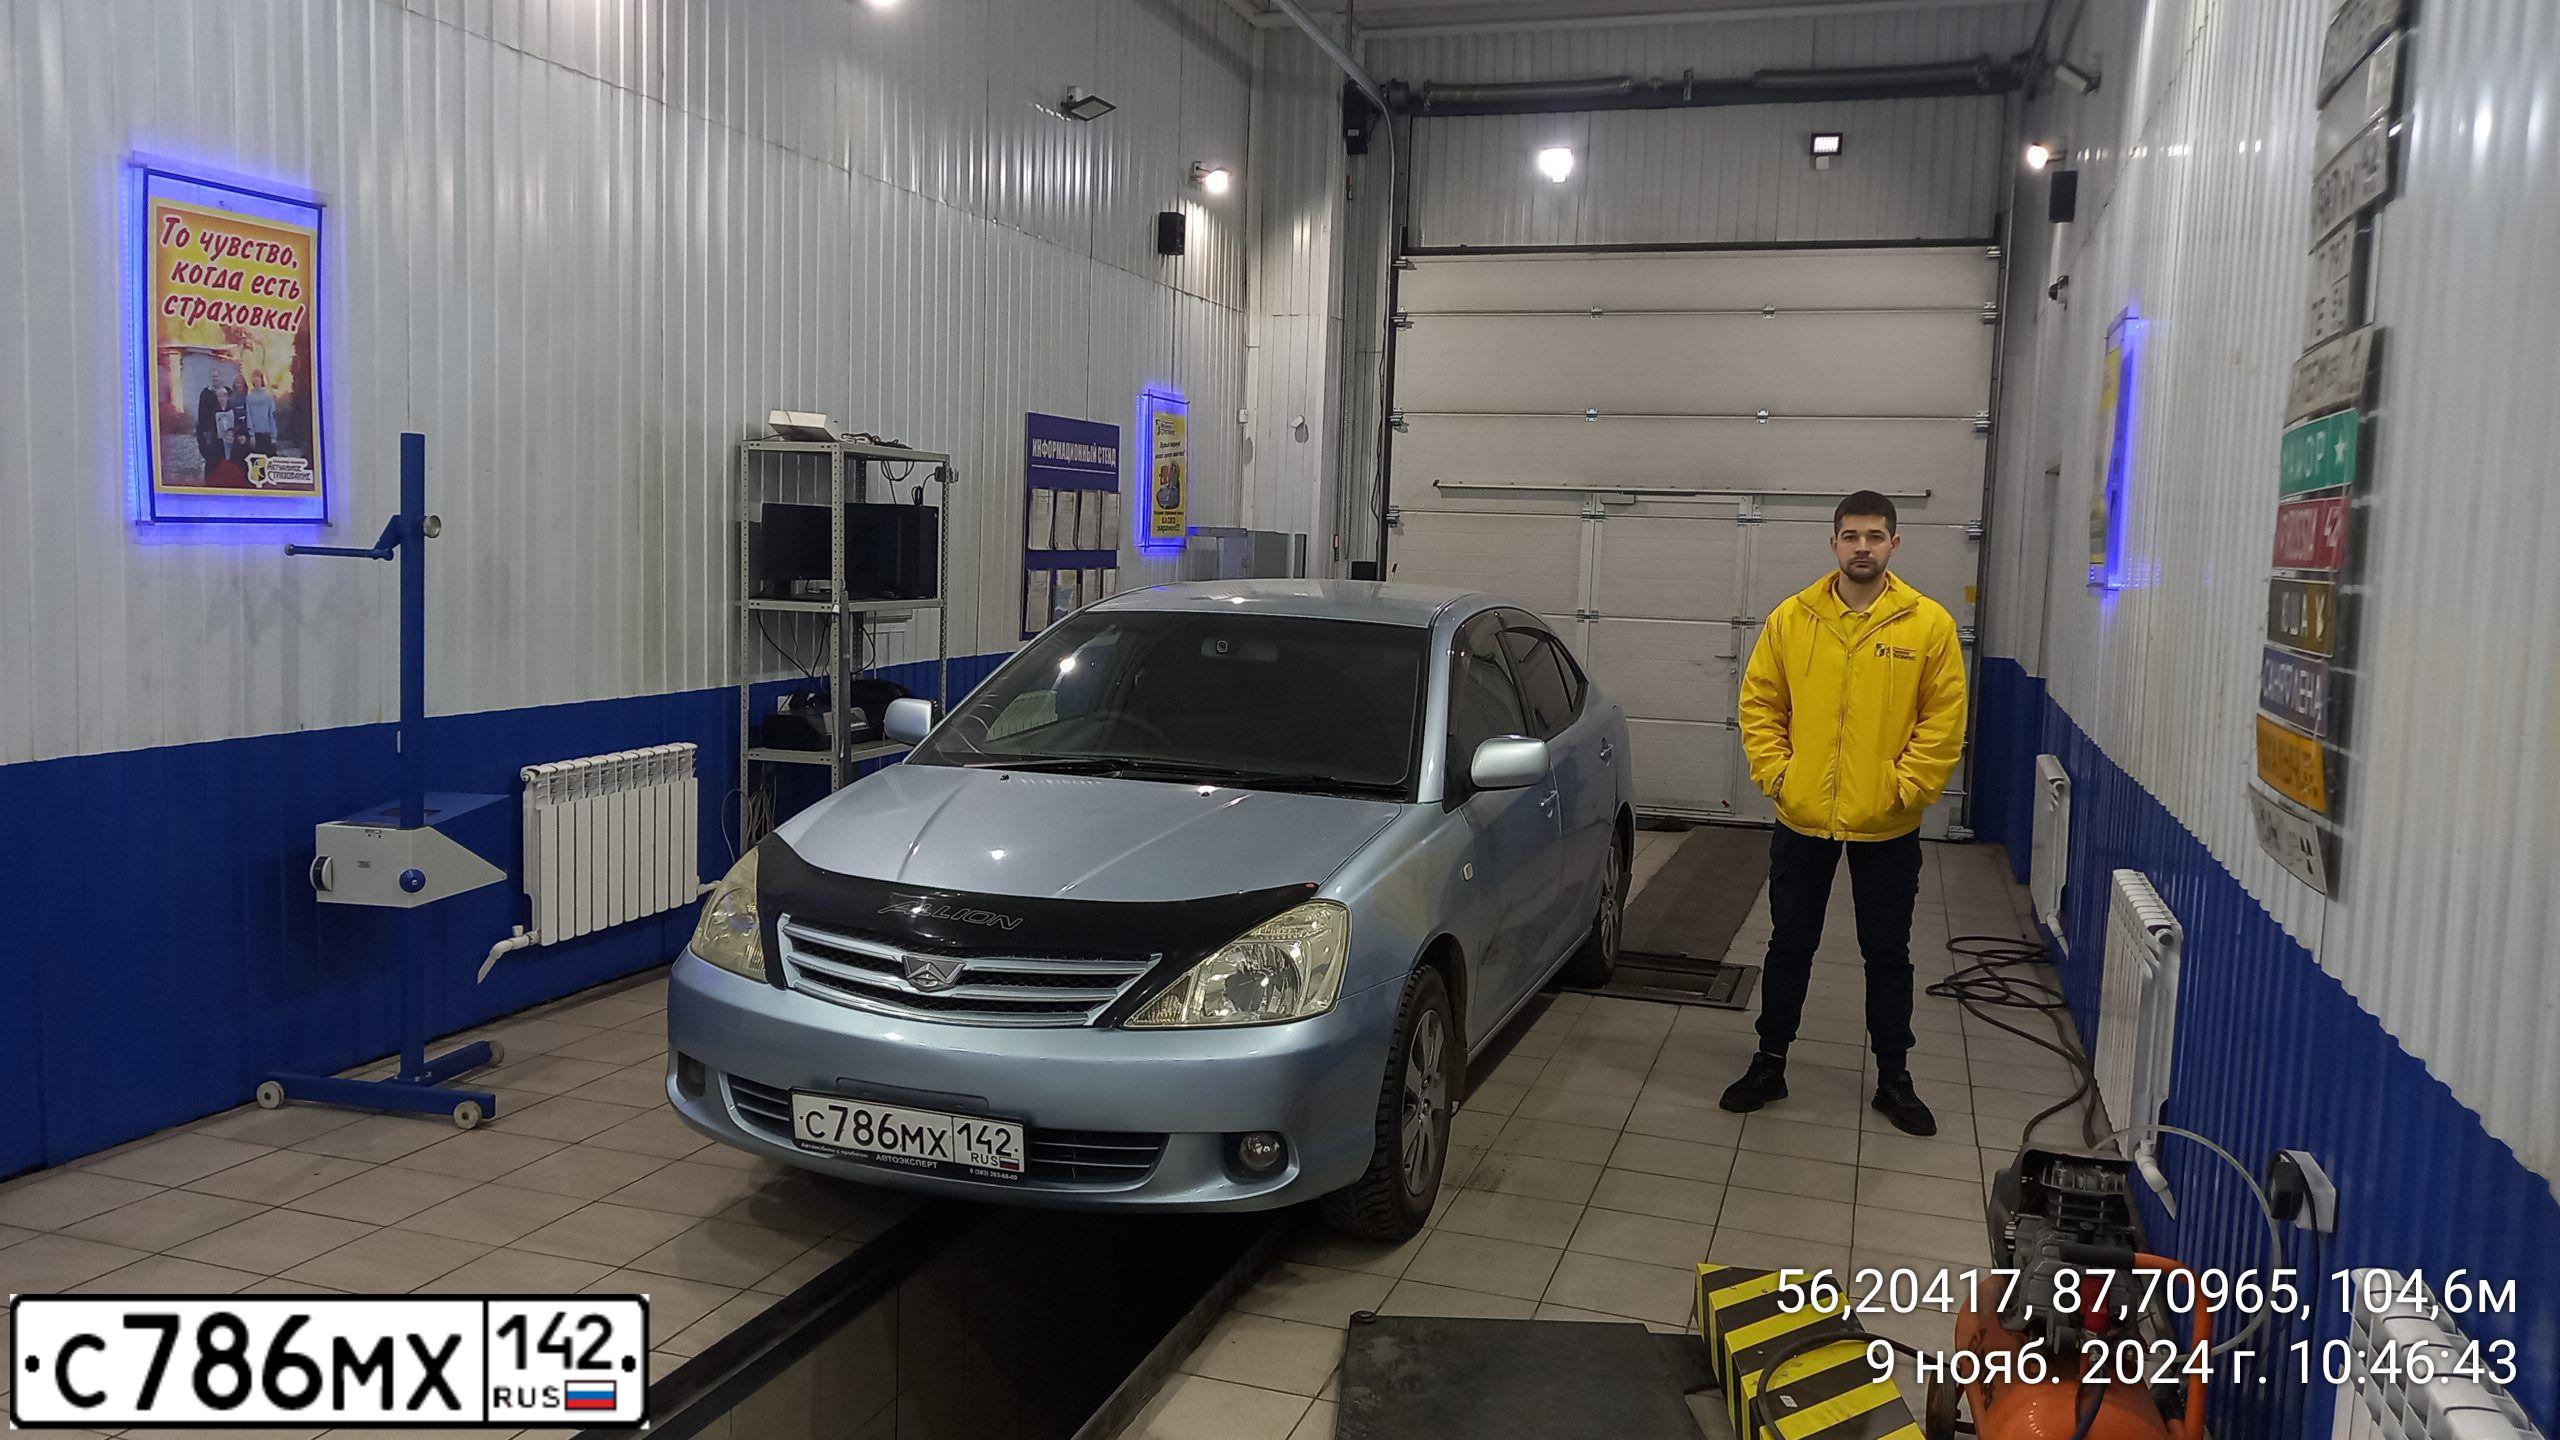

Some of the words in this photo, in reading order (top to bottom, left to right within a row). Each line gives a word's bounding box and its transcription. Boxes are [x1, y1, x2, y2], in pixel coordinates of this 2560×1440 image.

[162, 217, 190, 248] То
[199, 231, 297, 269] чувство,
[171, 261, 244, 291] когда
[251, 275, 300, 300] есть
[164, 295, 304, 332] страховка!
[1032, 438, 1097, 463] ИНФОРМАЦИОННЫЙ
[1097, 446, 1117, 468] СТЕНД
[877, 900, 1024, 931] ALLION
[805, 1104, 948, 1158] С786МХ
[956, 1122, 1012, 1158] 142
[875, 1153, 938, 1169] АВТОЭКСПЕРТ
[970, 1152, 999, 1167] RUS
